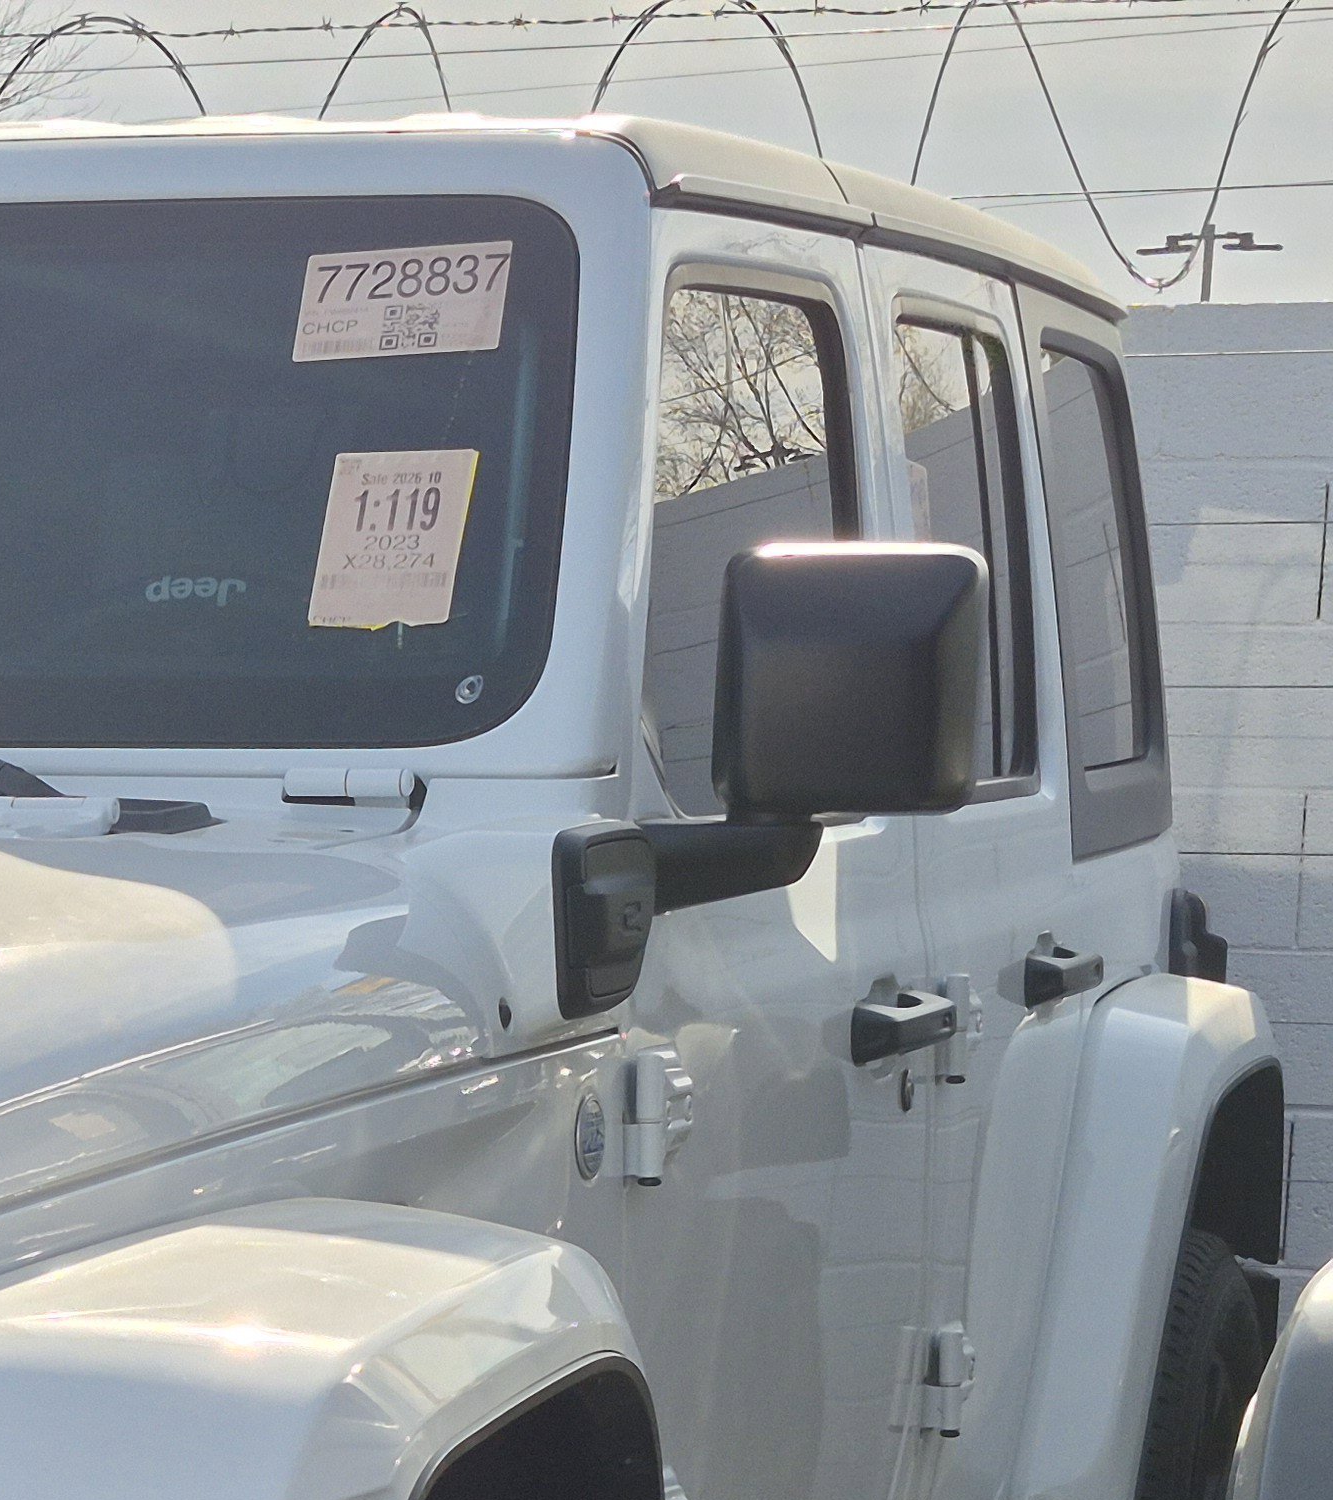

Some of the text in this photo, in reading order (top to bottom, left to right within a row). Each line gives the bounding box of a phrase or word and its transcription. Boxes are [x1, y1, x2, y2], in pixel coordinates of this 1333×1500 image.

[317, 252, 511, 304] 7728837
[302, 319, 359, 335] CHCP
[354, 486, 442, 533] 1:119
[363, 534, 421, 552] 2023
[341, 551, 436, 572] X28,274
[145, 575, 247, 607] Jeep
